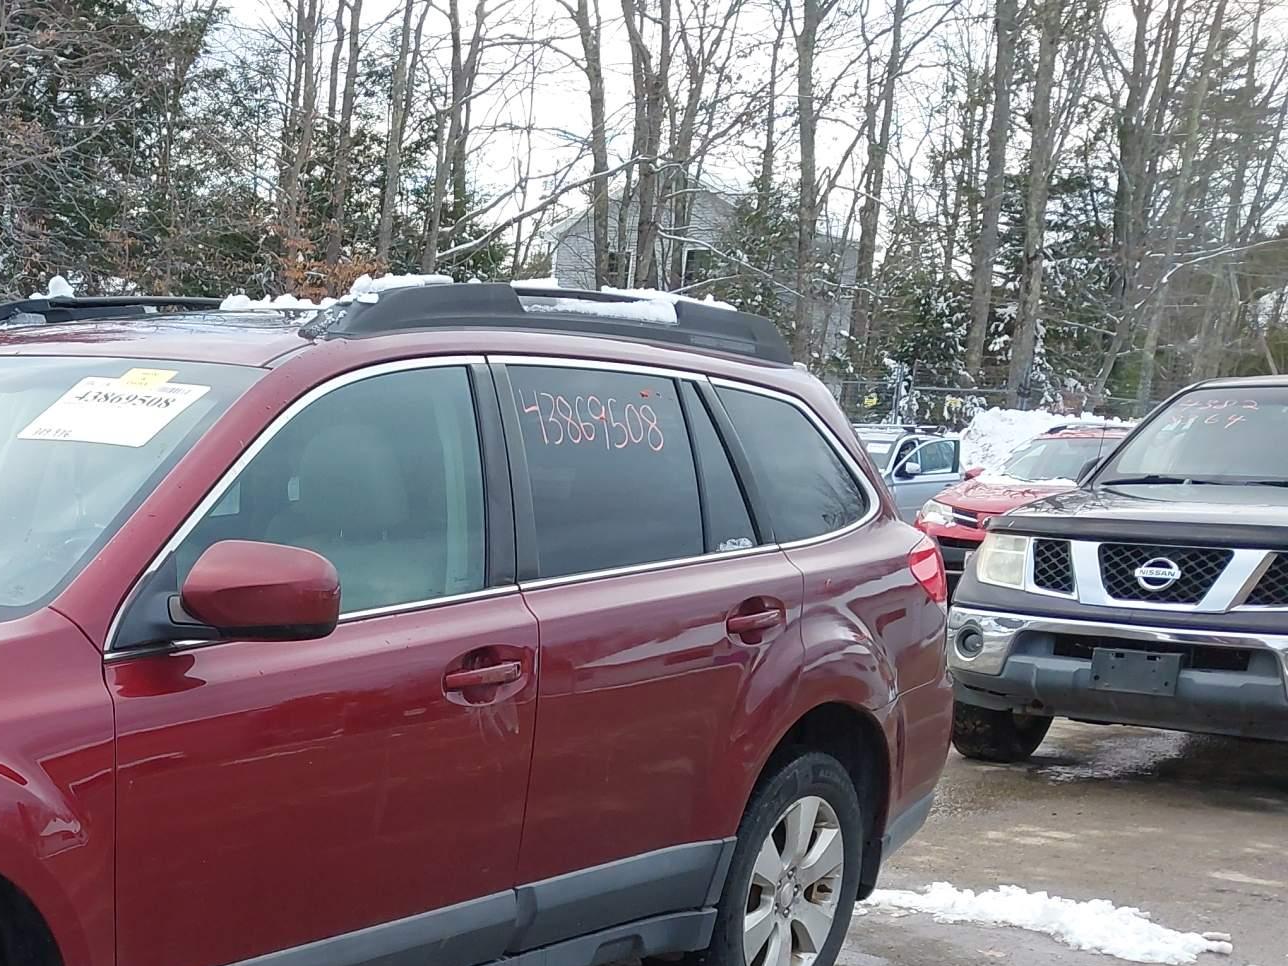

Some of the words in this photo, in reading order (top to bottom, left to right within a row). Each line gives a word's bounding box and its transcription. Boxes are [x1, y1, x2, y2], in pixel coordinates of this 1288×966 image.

[75, 389, 176, 409] 43869508
[518, 388, 664, 451] 43869508
[1138, 568, 1177, 578] NISSAN
